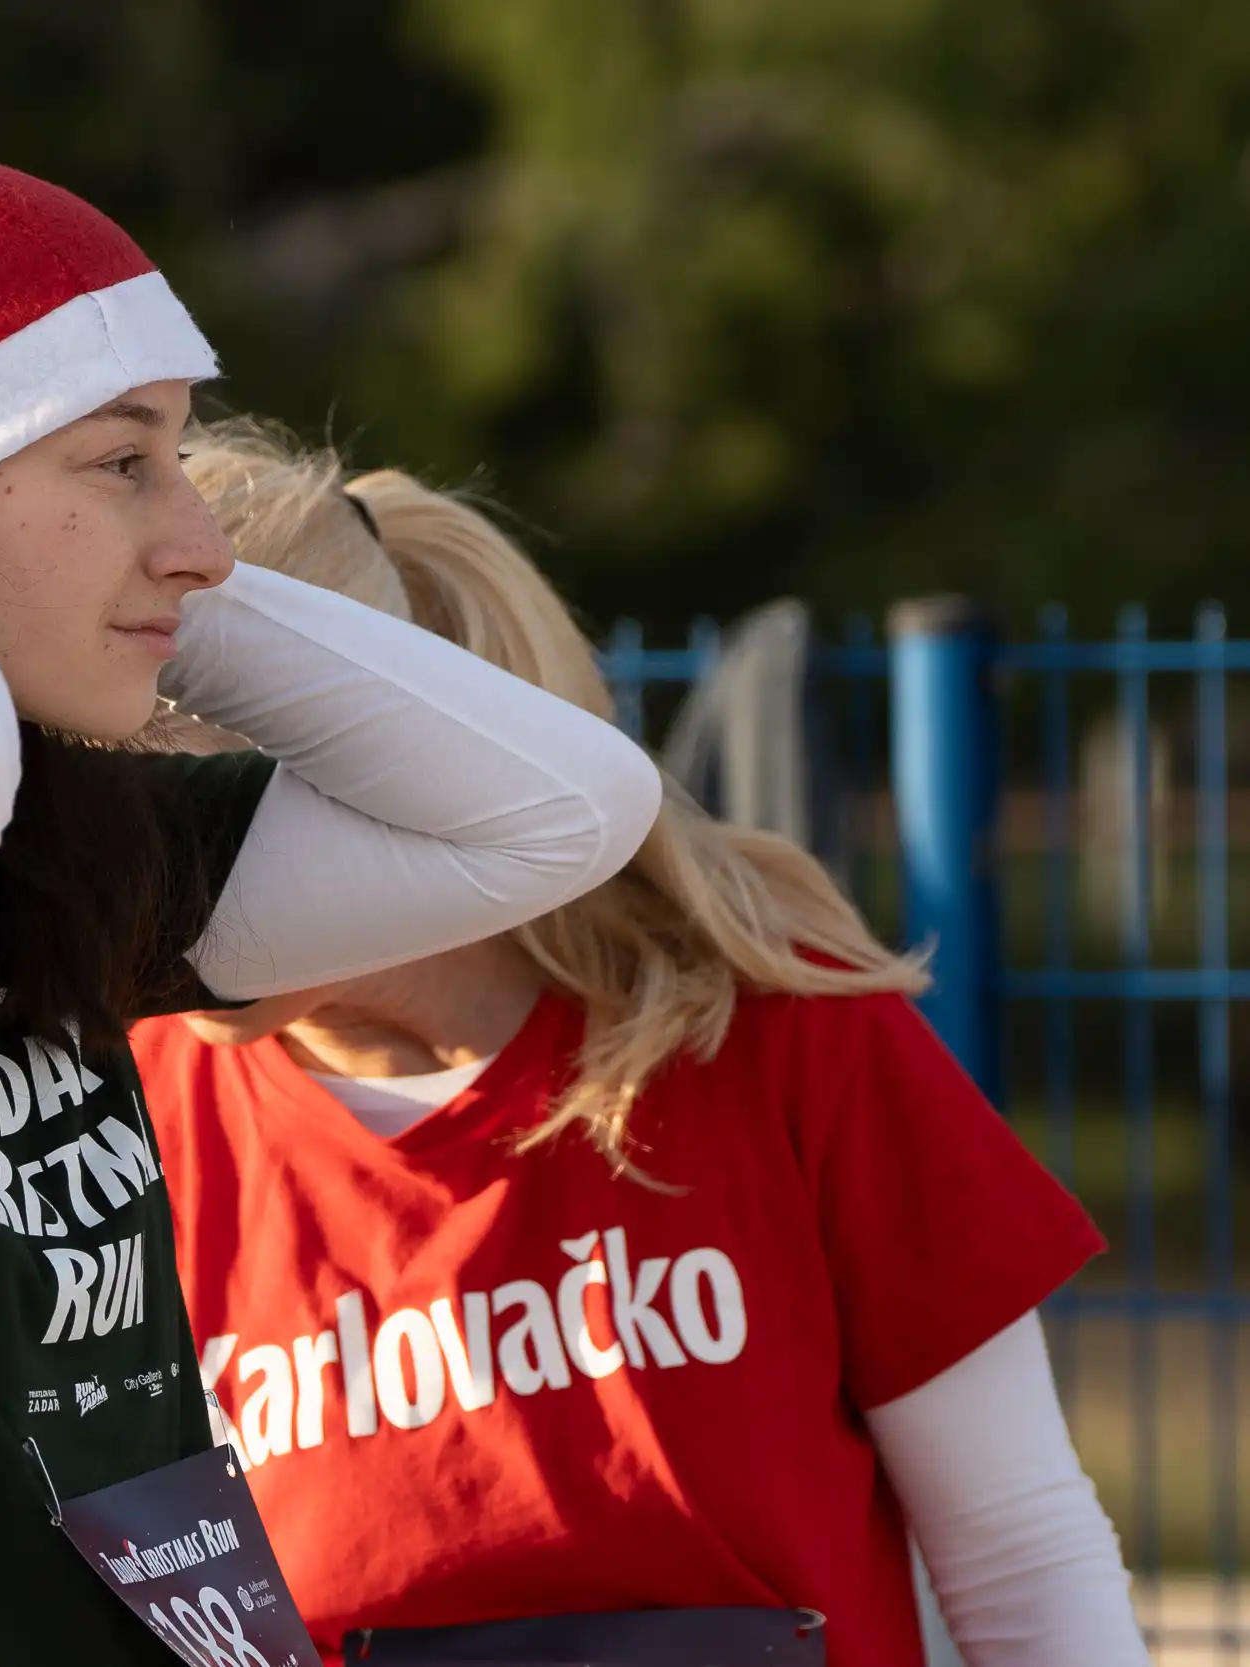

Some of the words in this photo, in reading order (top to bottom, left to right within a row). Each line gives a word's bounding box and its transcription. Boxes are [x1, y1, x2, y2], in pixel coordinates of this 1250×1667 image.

[75, 1381, 96, 1404] RUN
[80, 1384, 108, 1417] ZADAR
[28, 1398, 60, 1413] ZADAR
